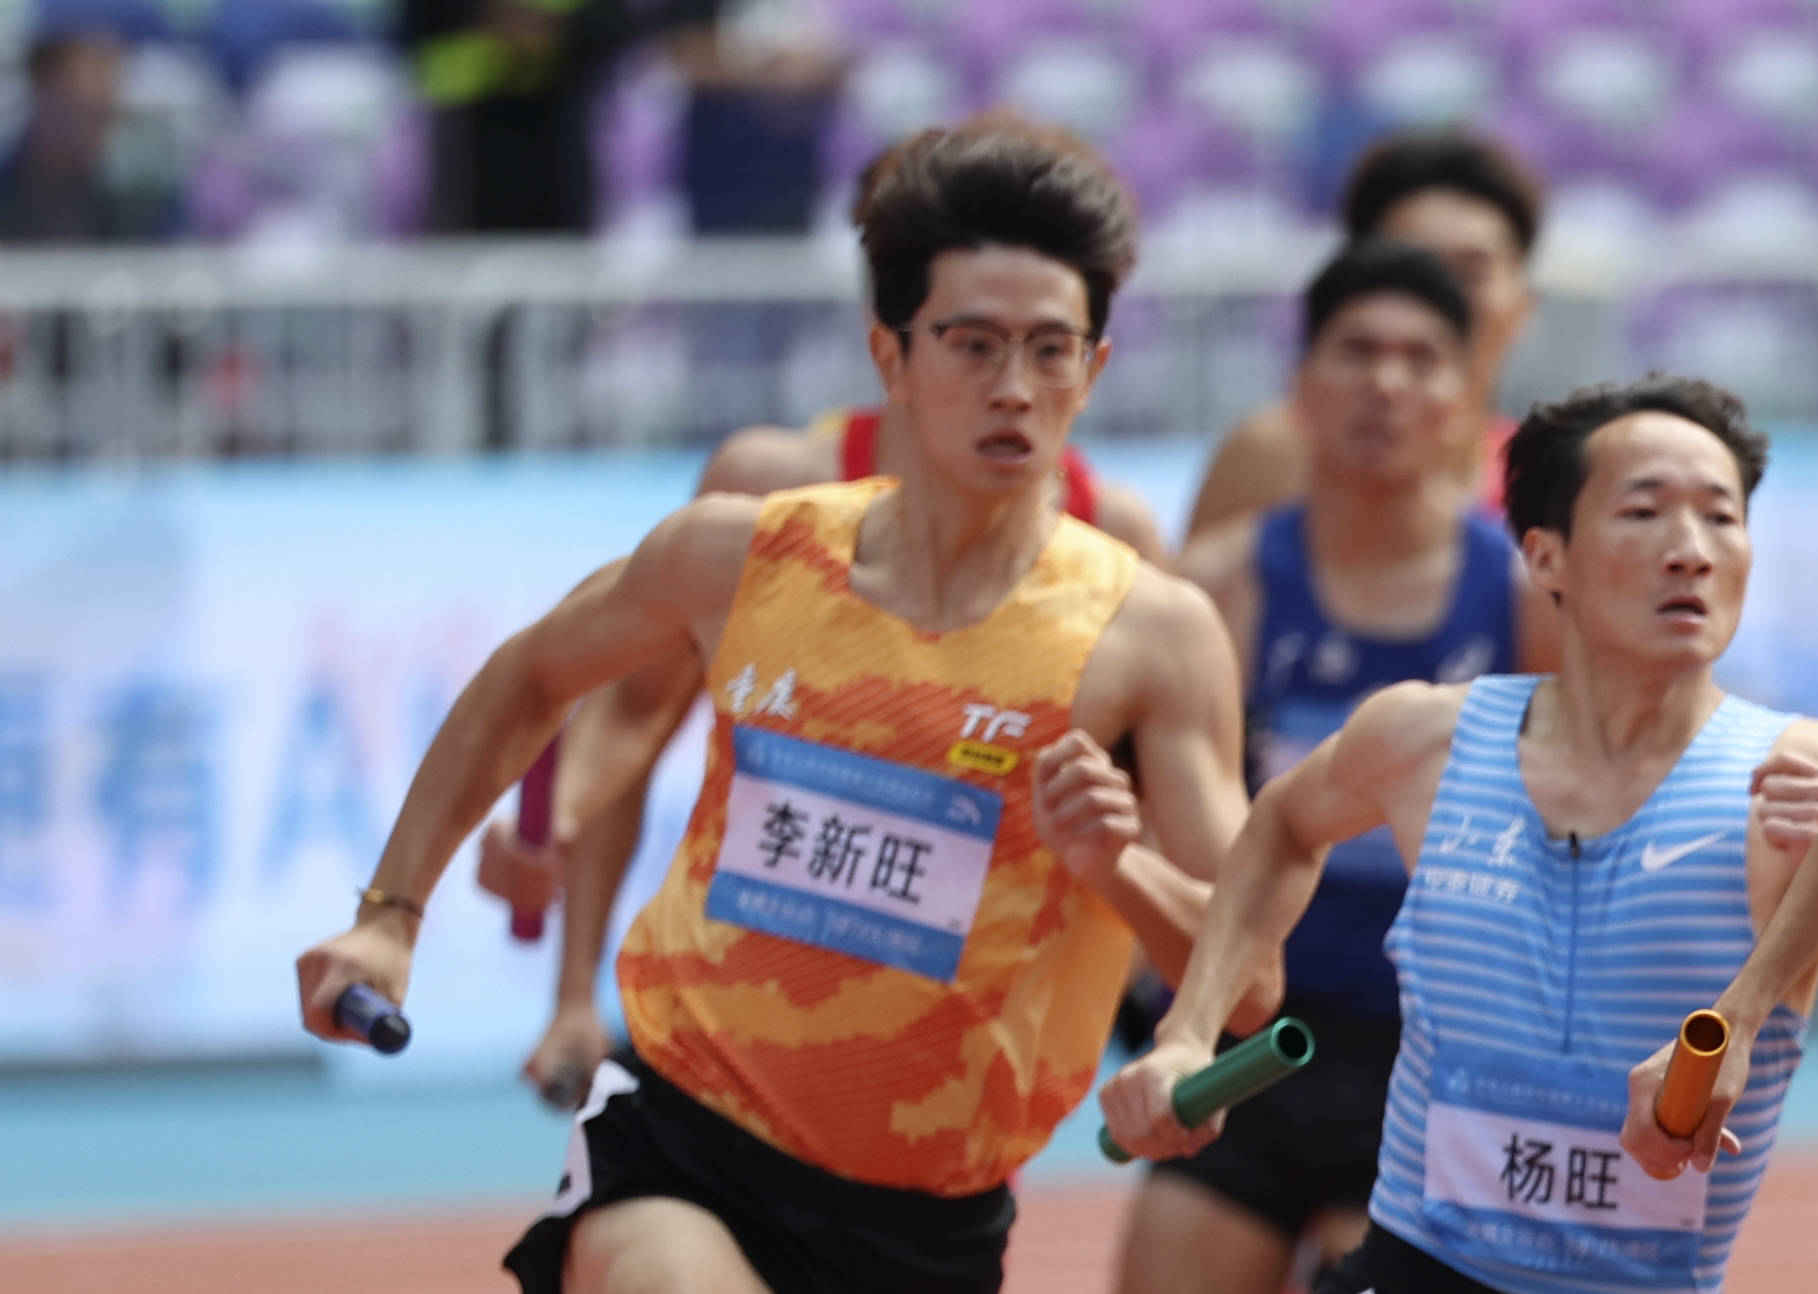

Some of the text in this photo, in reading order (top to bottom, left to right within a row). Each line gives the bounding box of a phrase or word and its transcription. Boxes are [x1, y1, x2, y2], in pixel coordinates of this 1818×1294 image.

[758, 800, 933, 905] 李新旺
[1501, 1133, 1621, 1210] 杨旺
